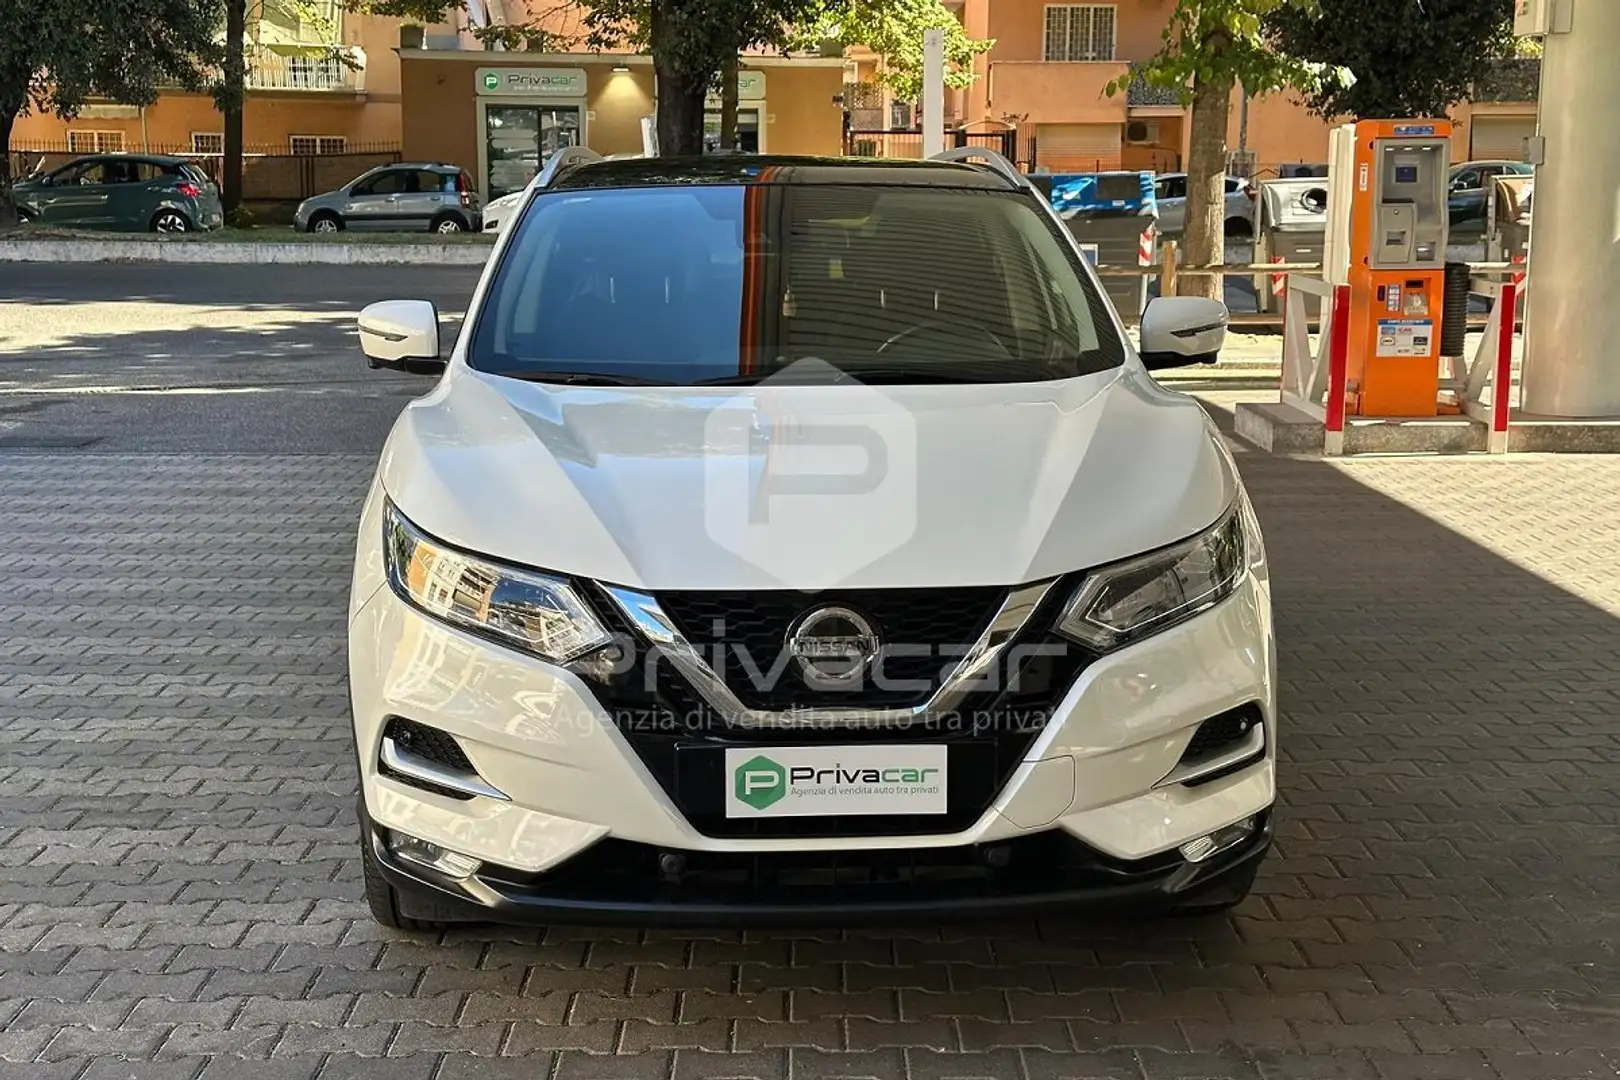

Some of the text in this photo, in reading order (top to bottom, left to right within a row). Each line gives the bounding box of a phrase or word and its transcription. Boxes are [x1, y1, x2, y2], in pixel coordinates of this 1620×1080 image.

[507, 72, 577, 85] Privacar
[799, 638, 870, 655] NISSAN
[745, 763, 939, 795] P Privacar
[790, 785, 939, 798] Agenzia di vendita auto tra privati
